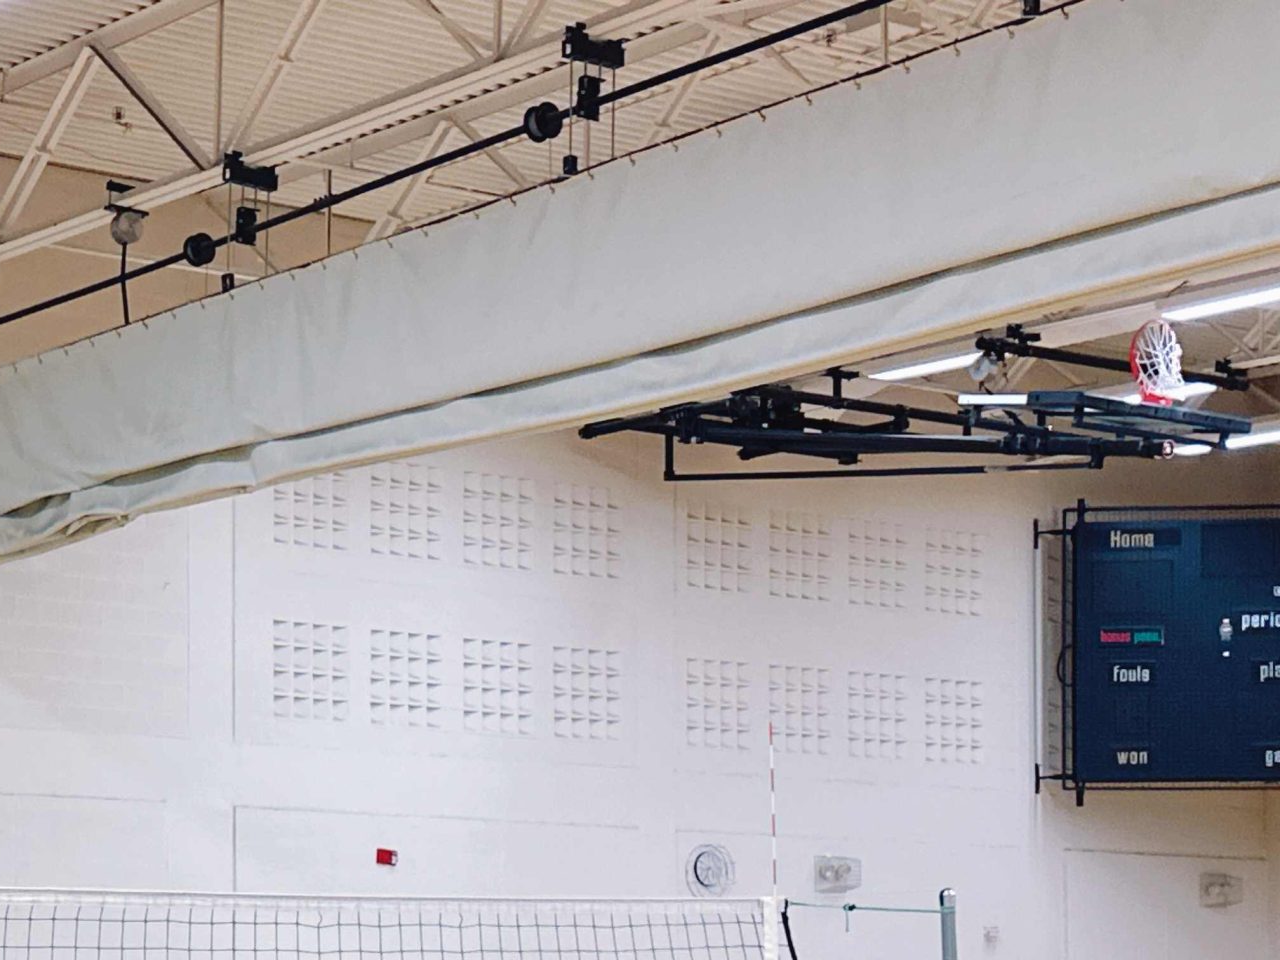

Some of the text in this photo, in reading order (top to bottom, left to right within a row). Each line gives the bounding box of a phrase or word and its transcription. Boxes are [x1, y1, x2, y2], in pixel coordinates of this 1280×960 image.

[1110, 530, 1154, 548] Home
[1113, 665, 1150, 682] fouls
[1117, 751, 1148, 765] won
